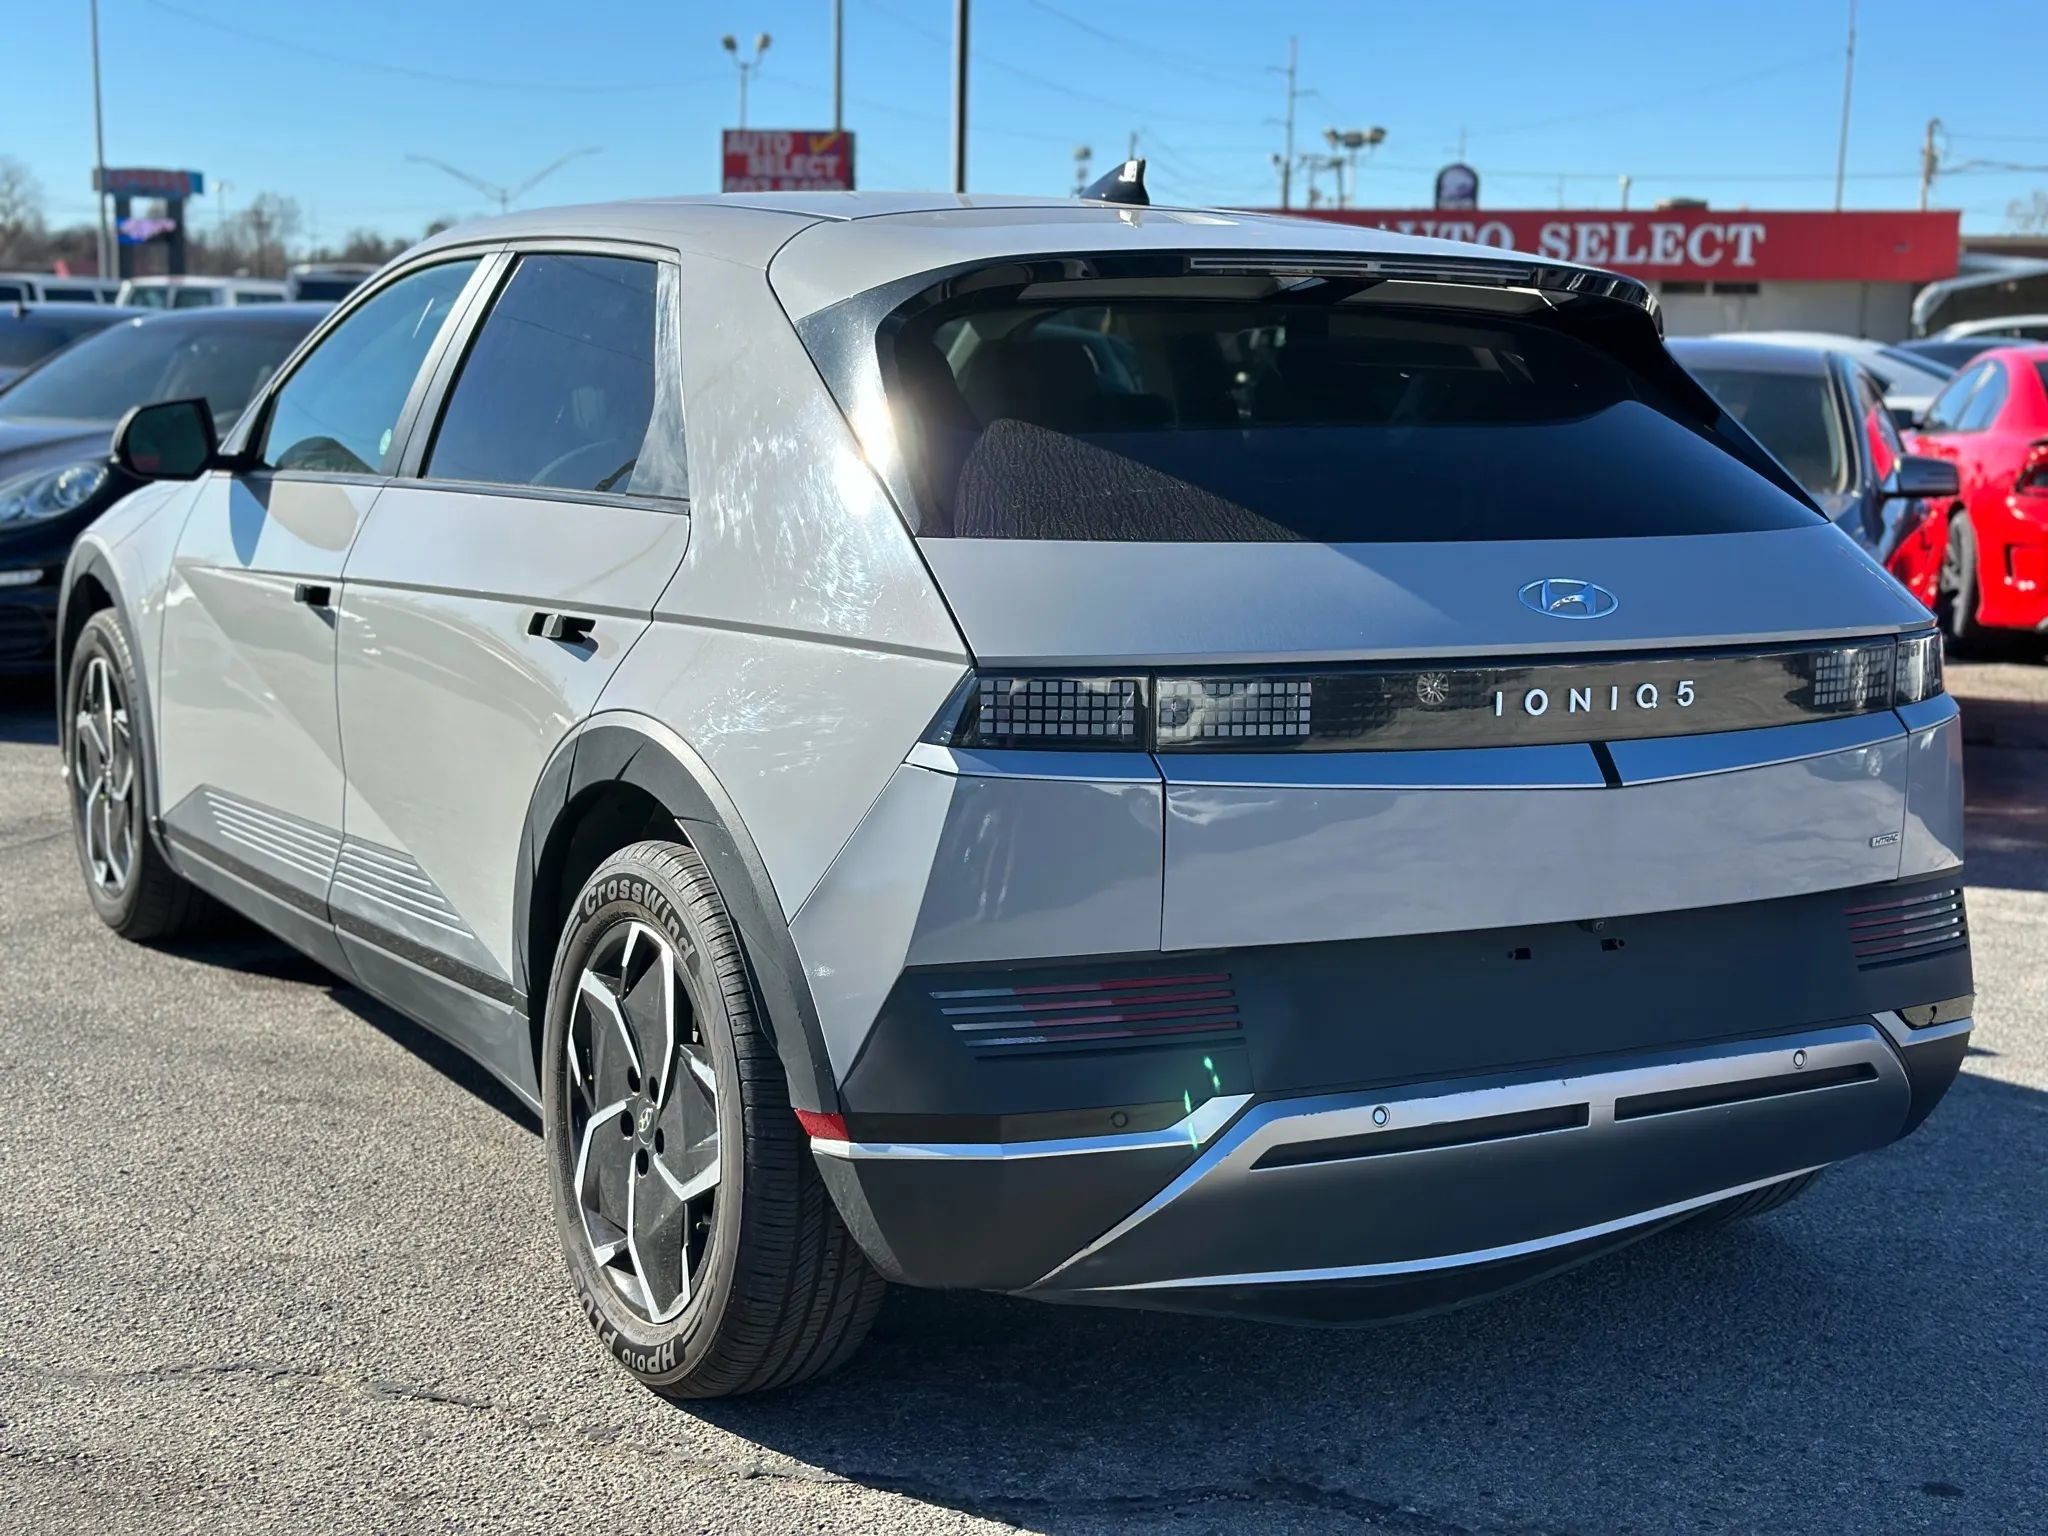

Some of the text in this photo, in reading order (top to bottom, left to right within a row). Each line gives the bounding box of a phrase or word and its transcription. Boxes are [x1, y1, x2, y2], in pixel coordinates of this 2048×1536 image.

[748, 154, 839, 178] SELECT
[1538, 221, 1767, 267] SELECT
[621, 1338, 677, 1373] HP010
